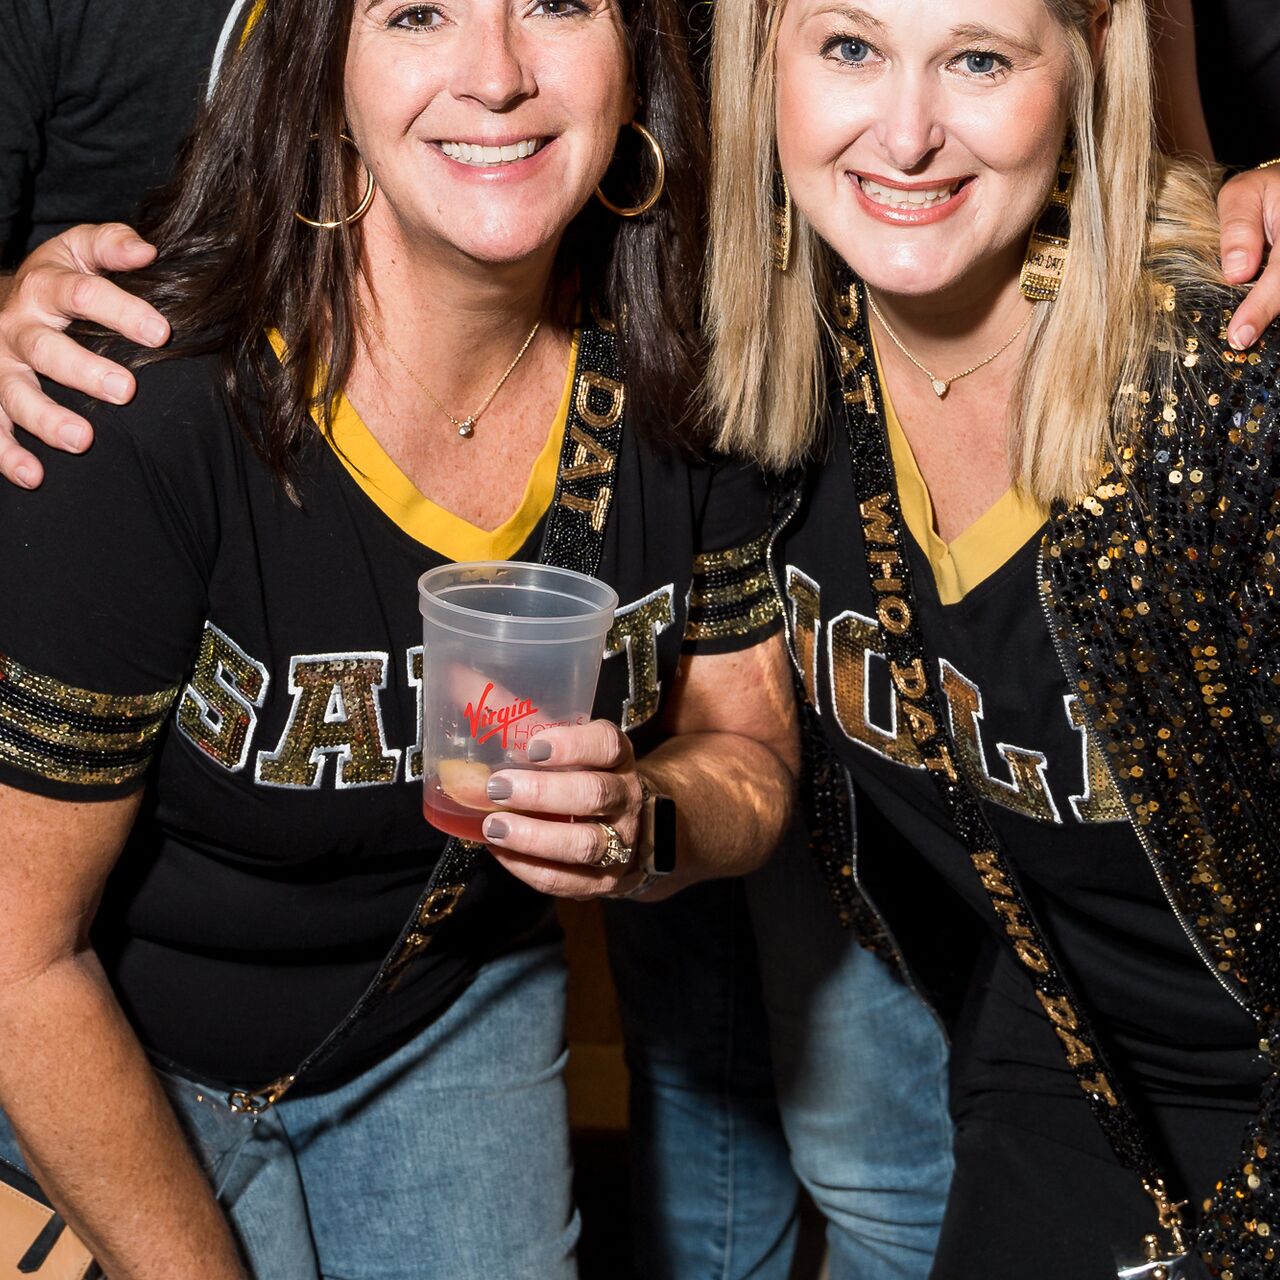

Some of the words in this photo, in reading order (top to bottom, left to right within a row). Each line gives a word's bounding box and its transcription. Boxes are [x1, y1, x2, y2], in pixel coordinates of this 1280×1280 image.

[560, 371, 624, 532] DAT
[463, 682, 539, 750] Virgin
[859, 491, 912, 634] WHO
[889, 657, 958, 783] DAT
[970, 850, 1049, 973] WHO
[1035, 988, 1118, 1108] DAT
